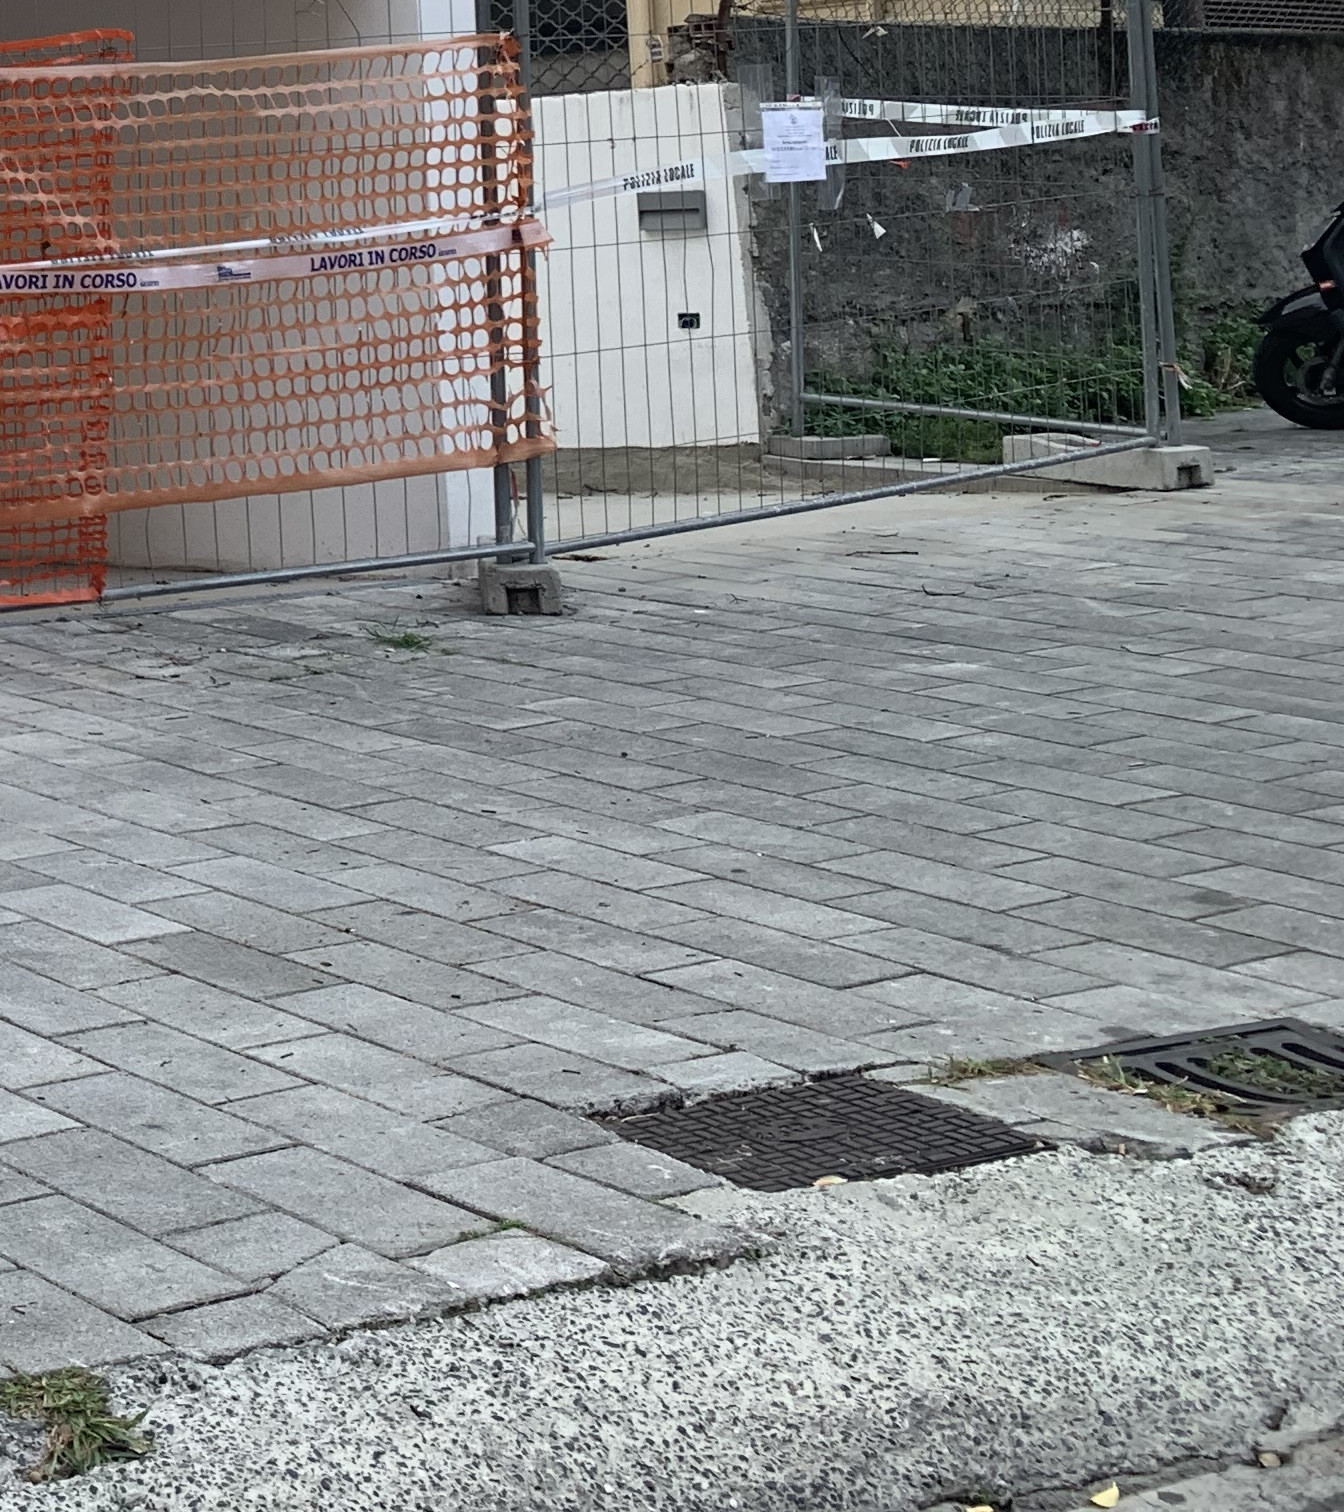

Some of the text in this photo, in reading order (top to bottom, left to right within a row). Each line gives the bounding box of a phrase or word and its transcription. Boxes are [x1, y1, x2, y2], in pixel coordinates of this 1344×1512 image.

[910, 135, 969, 152] POLIZIA LOCALE
[664, 163, 694, 182] LOCALE
[311, 243, 436, 272] LAVORI IN CORSO
[54, 274, 75, 289] IN
[80, 272, 137, 289] CORSO
